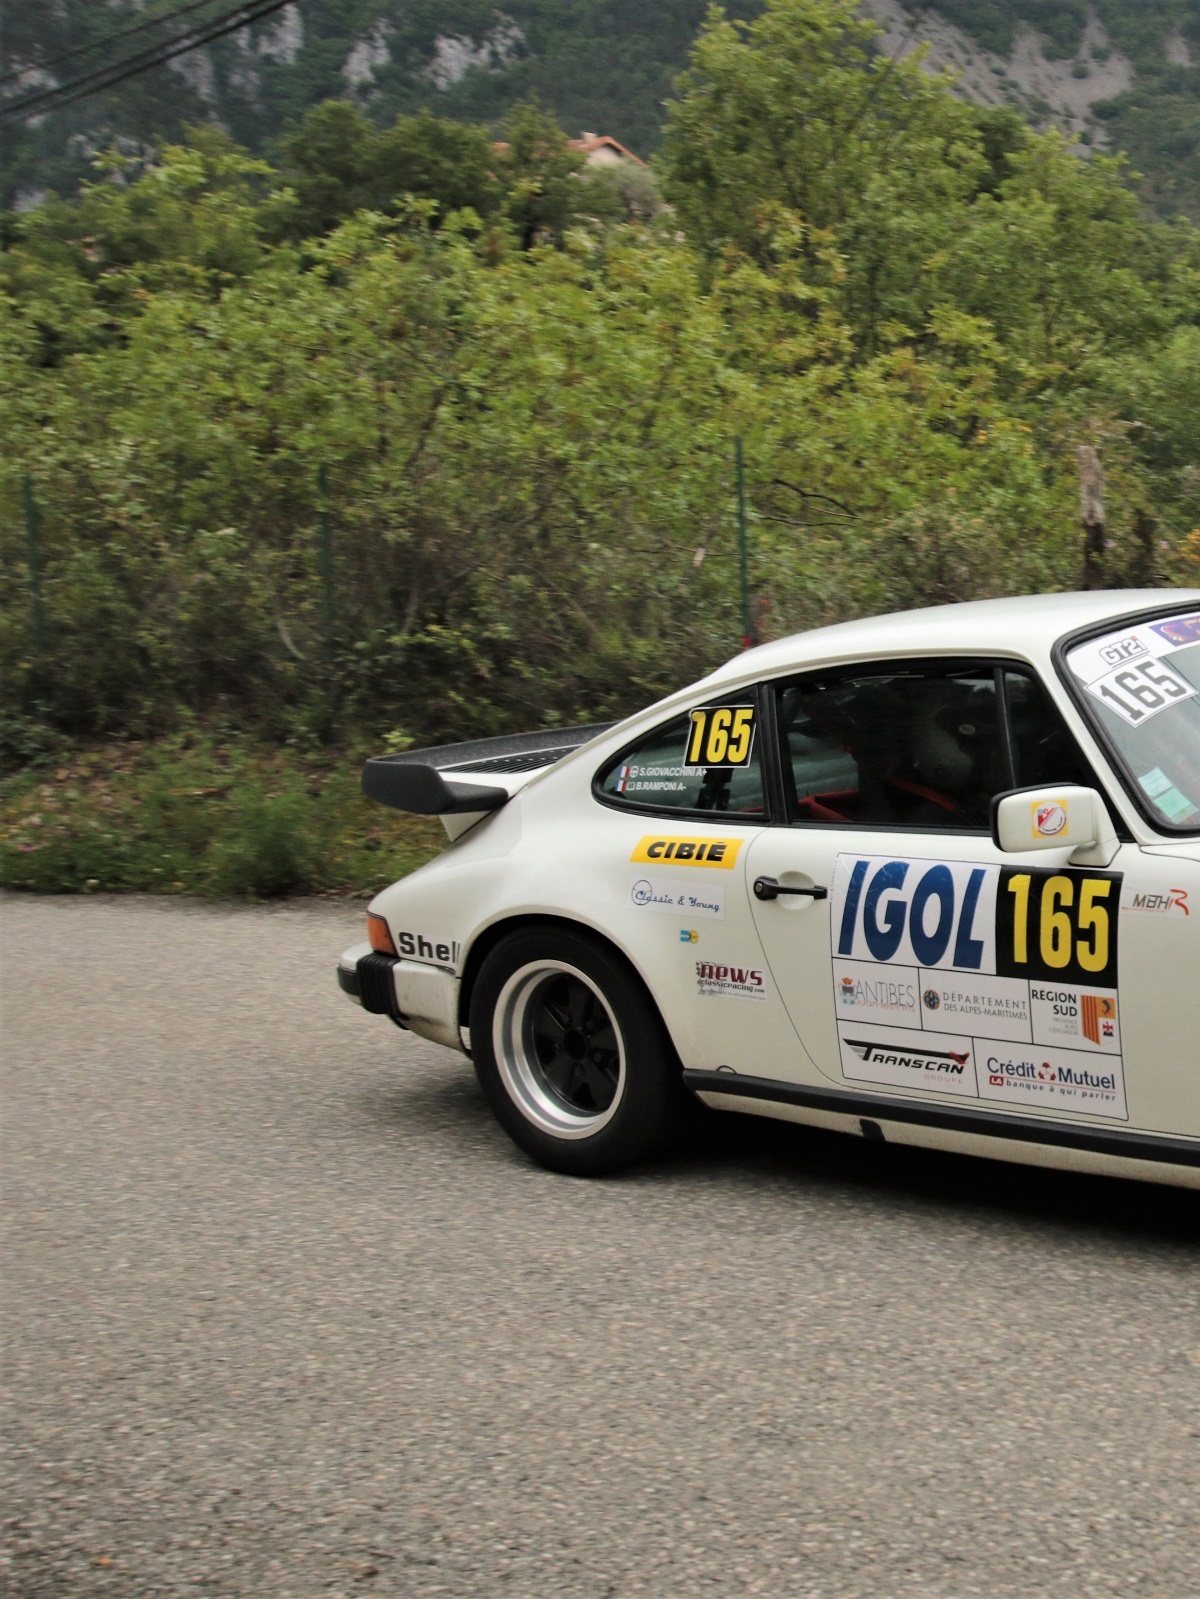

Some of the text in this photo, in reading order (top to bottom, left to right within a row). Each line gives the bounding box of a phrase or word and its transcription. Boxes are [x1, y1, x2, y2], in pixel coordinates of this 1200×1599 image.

[1100, 660, 1187, 721] 165
[689, 708, 754, 763] 165
[688, 896, 721, 913] Young
[838, 860, 987, 970] IGOL
[1007, 873, 1112, 973] 165
[699, 963, 764, 986] news
[855, 979, 916, 1009] ANTIBES
[943, 992, 1027, 1010] DÉPARTEMENT
[944, 1003, 1028, 1021] DES ALPES-MARITIMES
[1053, 1004, 1078, 1017] SUD
[842, 1038, 970, 1075] TRANSCAN
[987, 1057, 1116, 1090] Crédit Mutuel
[1006, 1079, 1044, 1091] banque
[1060, 1088, 1077, 1097] qui
[1082, 1091, 1116, 1101] parler
